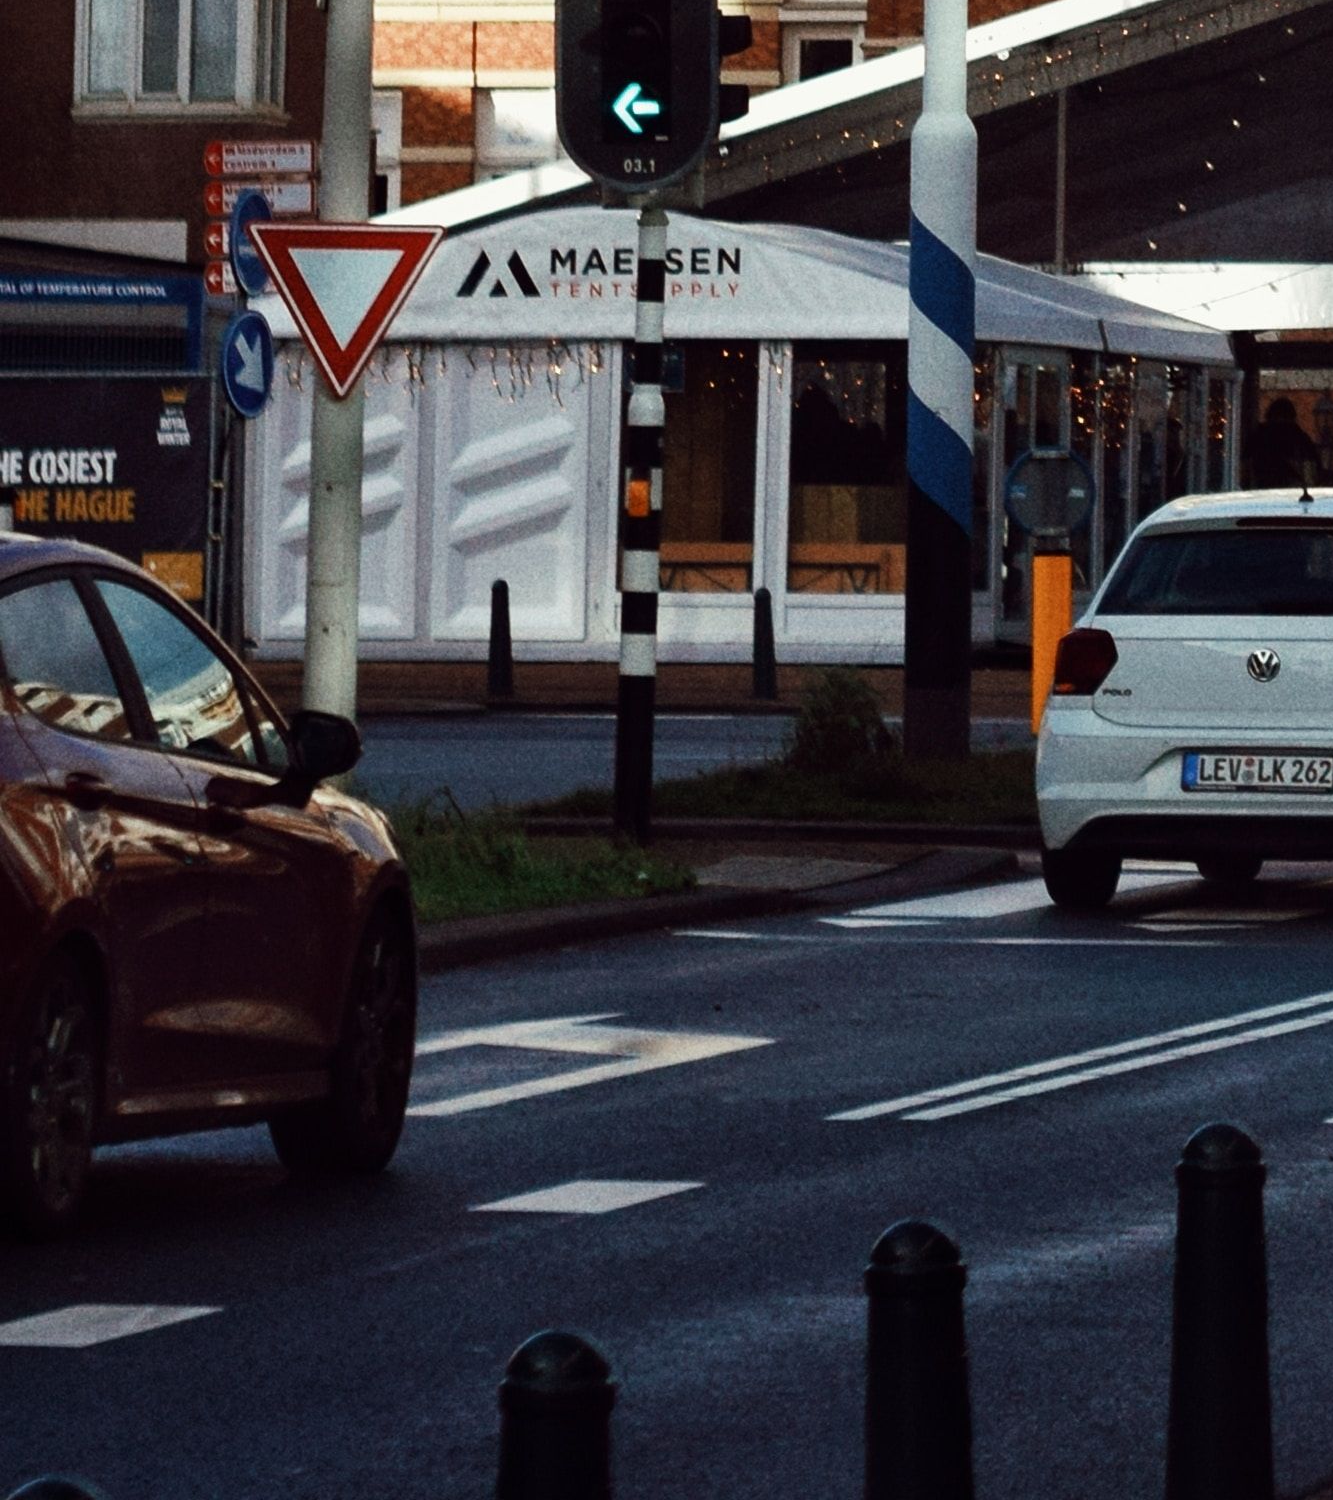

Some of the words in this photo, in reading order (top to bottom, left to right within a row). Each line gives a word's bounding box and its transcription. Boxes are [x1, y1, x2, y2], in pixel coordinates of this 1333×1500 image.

[623, 158, 656, 174] 03.1
[550, 247, 741, 276] MAESEN
[36, 282, 114, 297] TEMPERATURE
[550, 281, 740, 298] TENTSPPLY
[28, 449, 118, 485] COSIEST
[17, 489, 50, 522] HE
[55, 489, 136, 522] HAGUE
[1102, 688, 1133, 697] POLO
[1199, 757, 1243, 783] LEV
[1257, 758, 1286, 784] LK
[1291, 759, 1333, 785] 262
